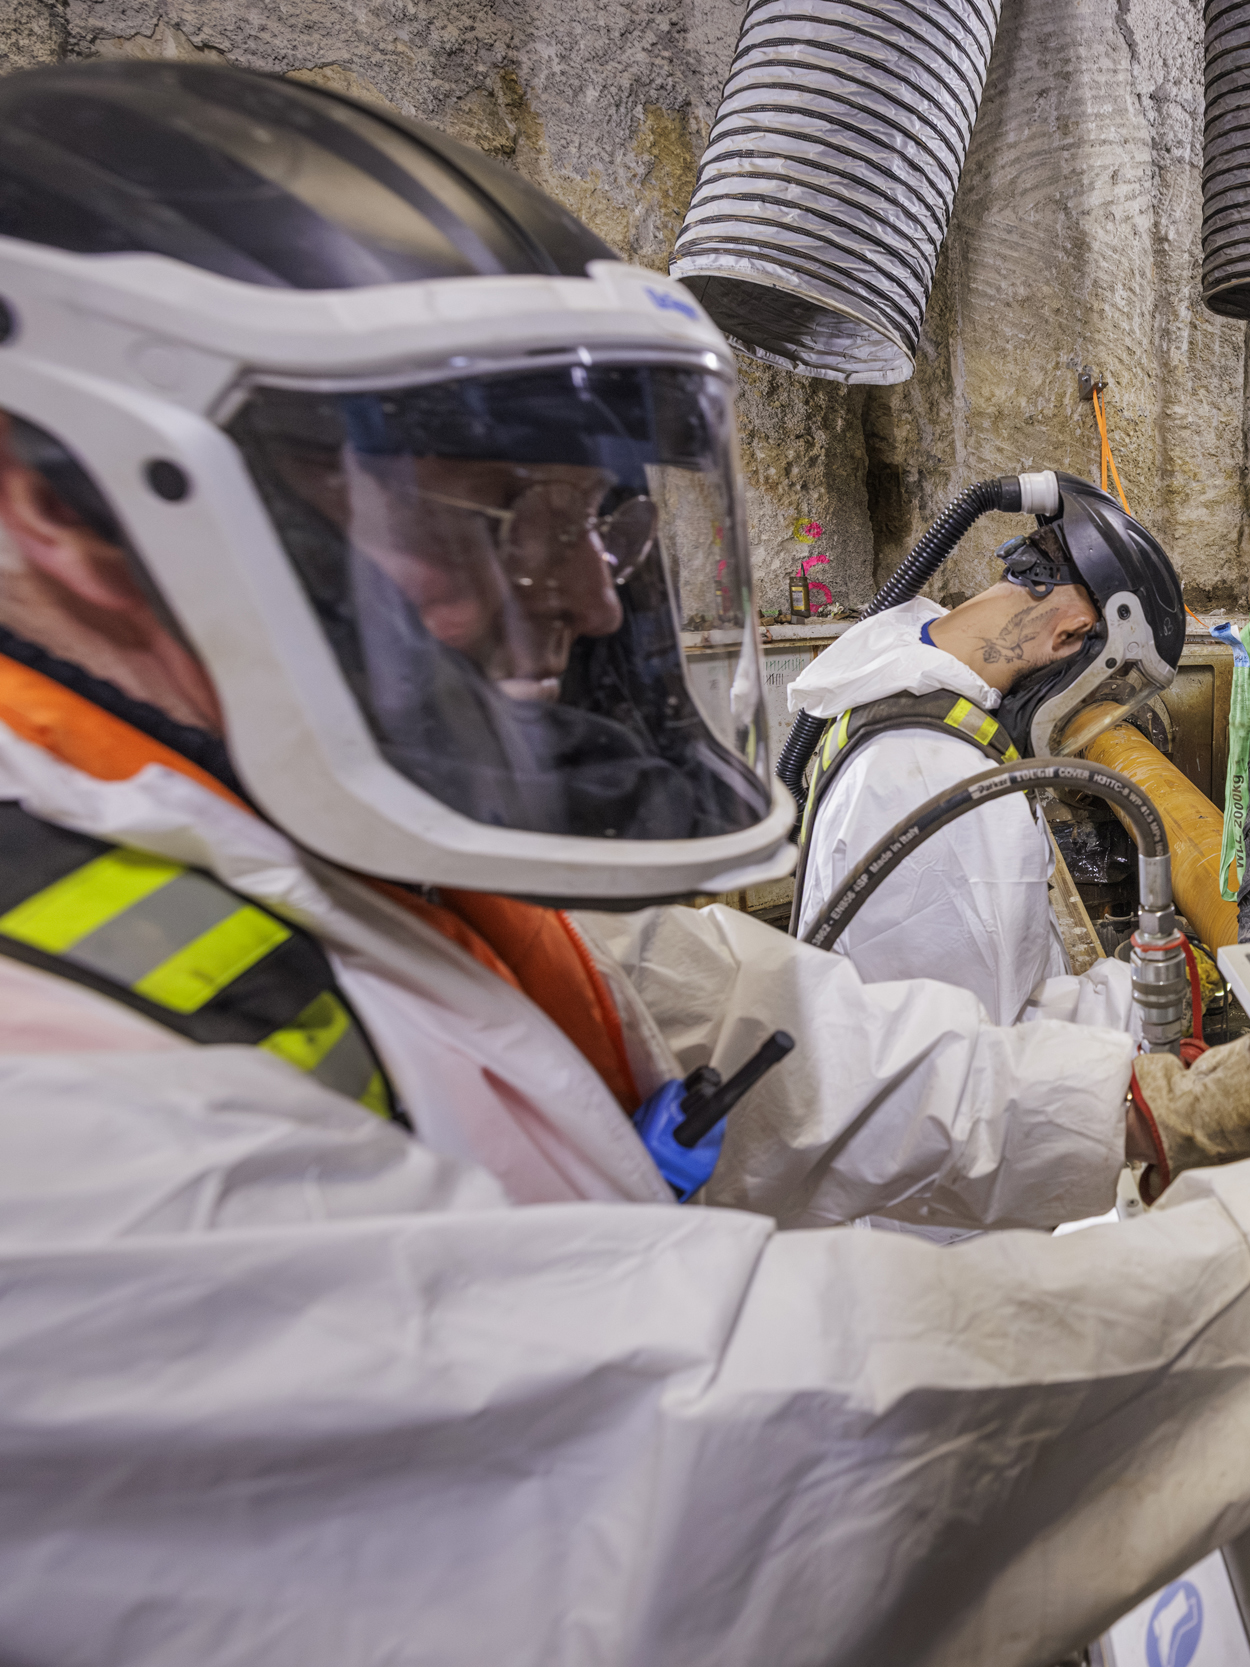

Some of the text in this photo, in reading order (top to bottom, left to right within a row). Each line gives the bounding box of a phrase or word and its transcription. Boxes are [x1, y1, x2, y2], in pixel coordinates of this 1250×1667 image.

[1016, 768, 1054, 782] TOUGH
[1058, 767, 1090, 780] COVER
[852, 872, 870, 893] 4SP
[868, 849, 894, 874] Made
[890, 840, 902, 853] in
[898, 826, 920, 848] Italy
